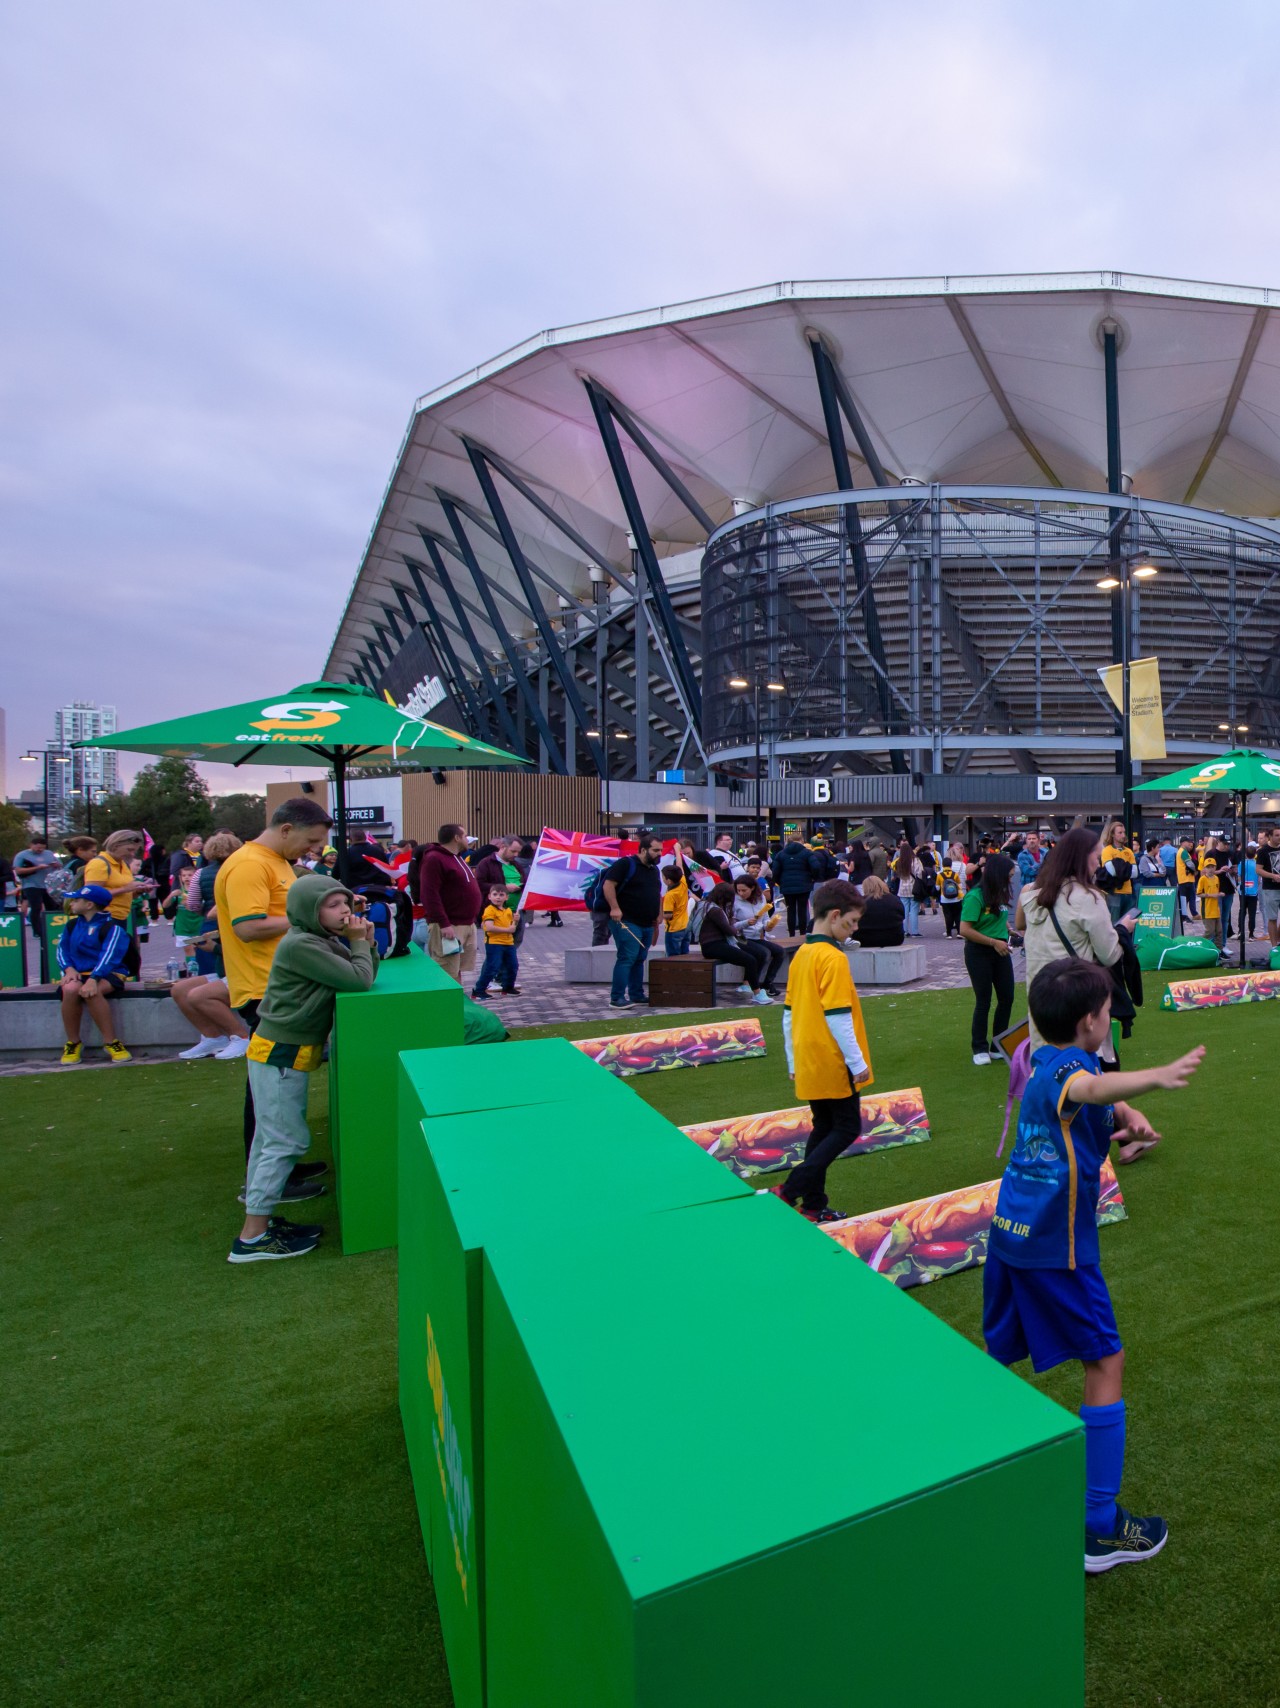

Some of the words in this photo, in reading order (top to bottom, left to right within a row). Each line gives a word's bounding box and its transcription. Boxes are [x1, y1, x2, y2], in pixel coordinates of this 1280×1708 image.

[814, 779, 831, 803] B
[1037, 776, 1058, 801] B
[348, 810, 369, 820] OFFICE
[369, 809, 374, 819] B
[1138, 918, 1155, 928] tag
[1012, 1221, 1031, 1238] LIFE
